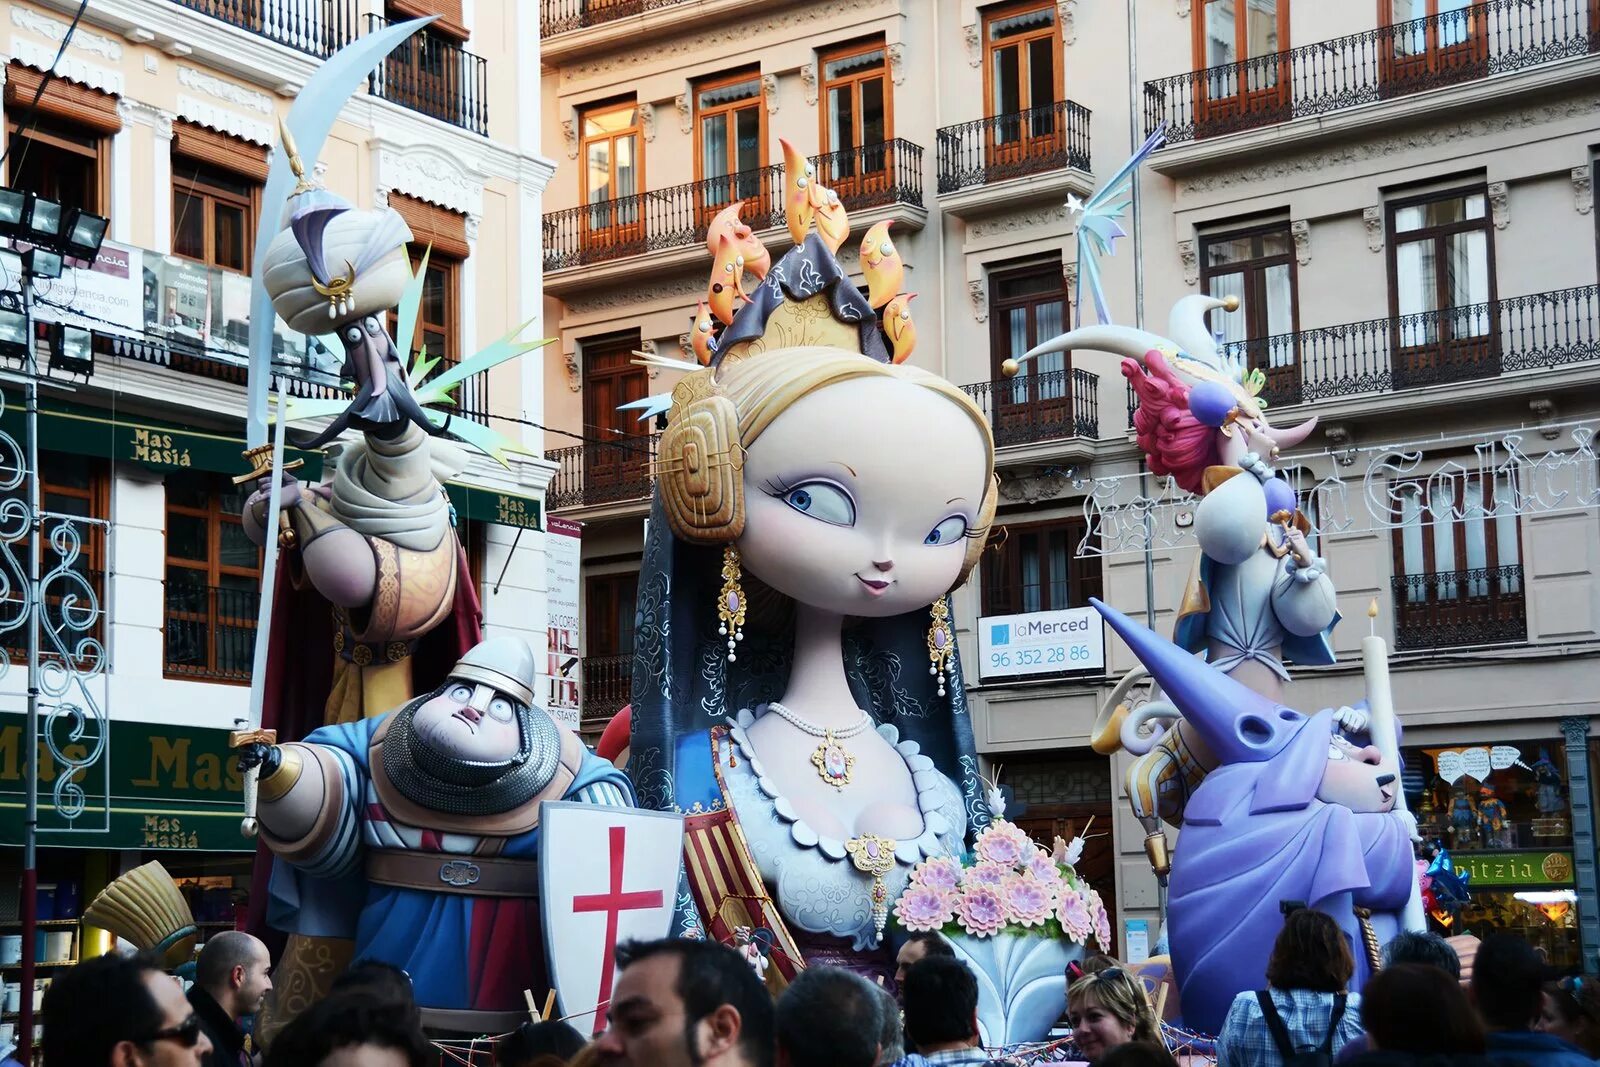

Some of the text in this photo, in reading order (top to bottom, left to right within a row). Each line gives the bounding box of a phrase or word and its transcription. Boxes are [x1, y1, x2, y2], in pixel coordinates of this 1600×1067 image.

[130, 428, 172, 449] Mas
[130, 445, 192, 468] Masiá
[495, 495, 525, 513] Mas
[495, 509, 538, 529] Masiá
[991, 645, 1090, 668] 96 352 28 86
[557, 710, 578, 723] STAYS
[140, 815, 181, 832] Mas
[140, 830, 199, 849] Masiá
